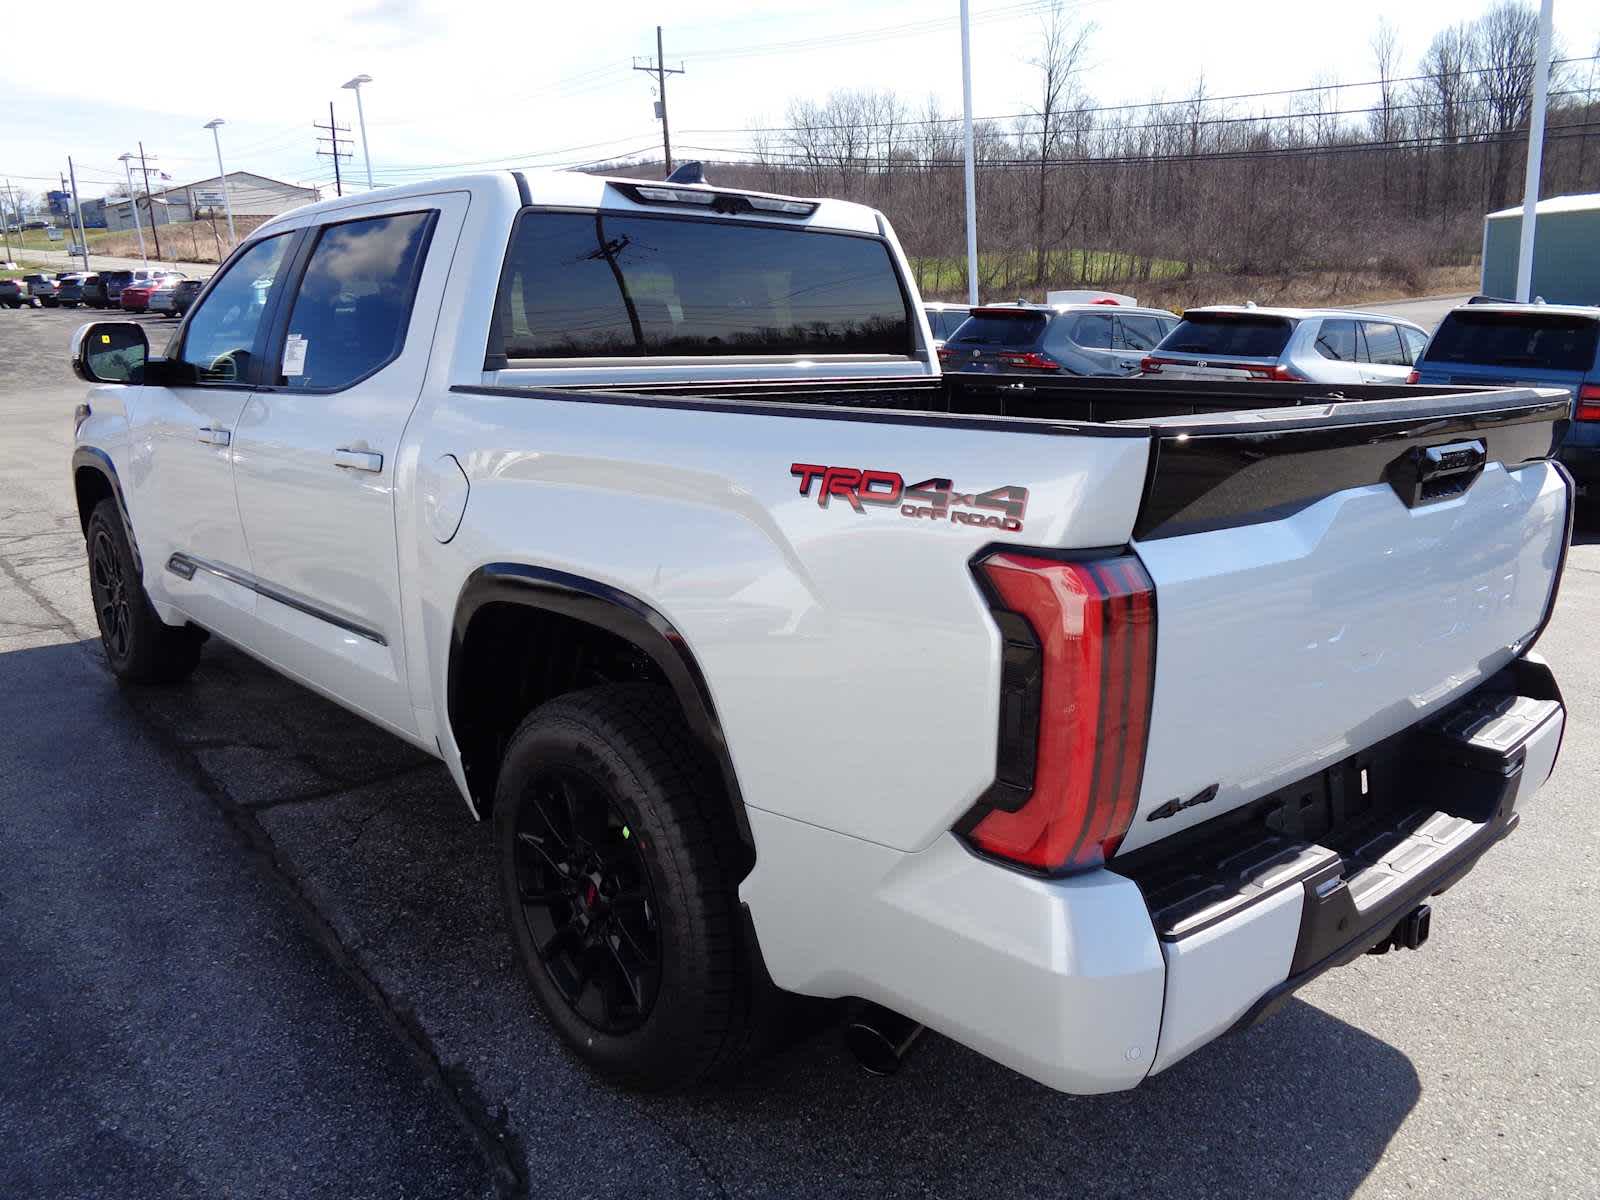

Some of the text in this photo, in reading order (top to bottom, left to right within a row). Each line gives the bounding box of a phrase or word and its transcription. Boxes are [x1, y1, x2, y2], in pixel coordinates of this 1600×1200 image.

[791, 463, 904, 514] TRD
[901, 504, 1024, 532] OFF ROAD
